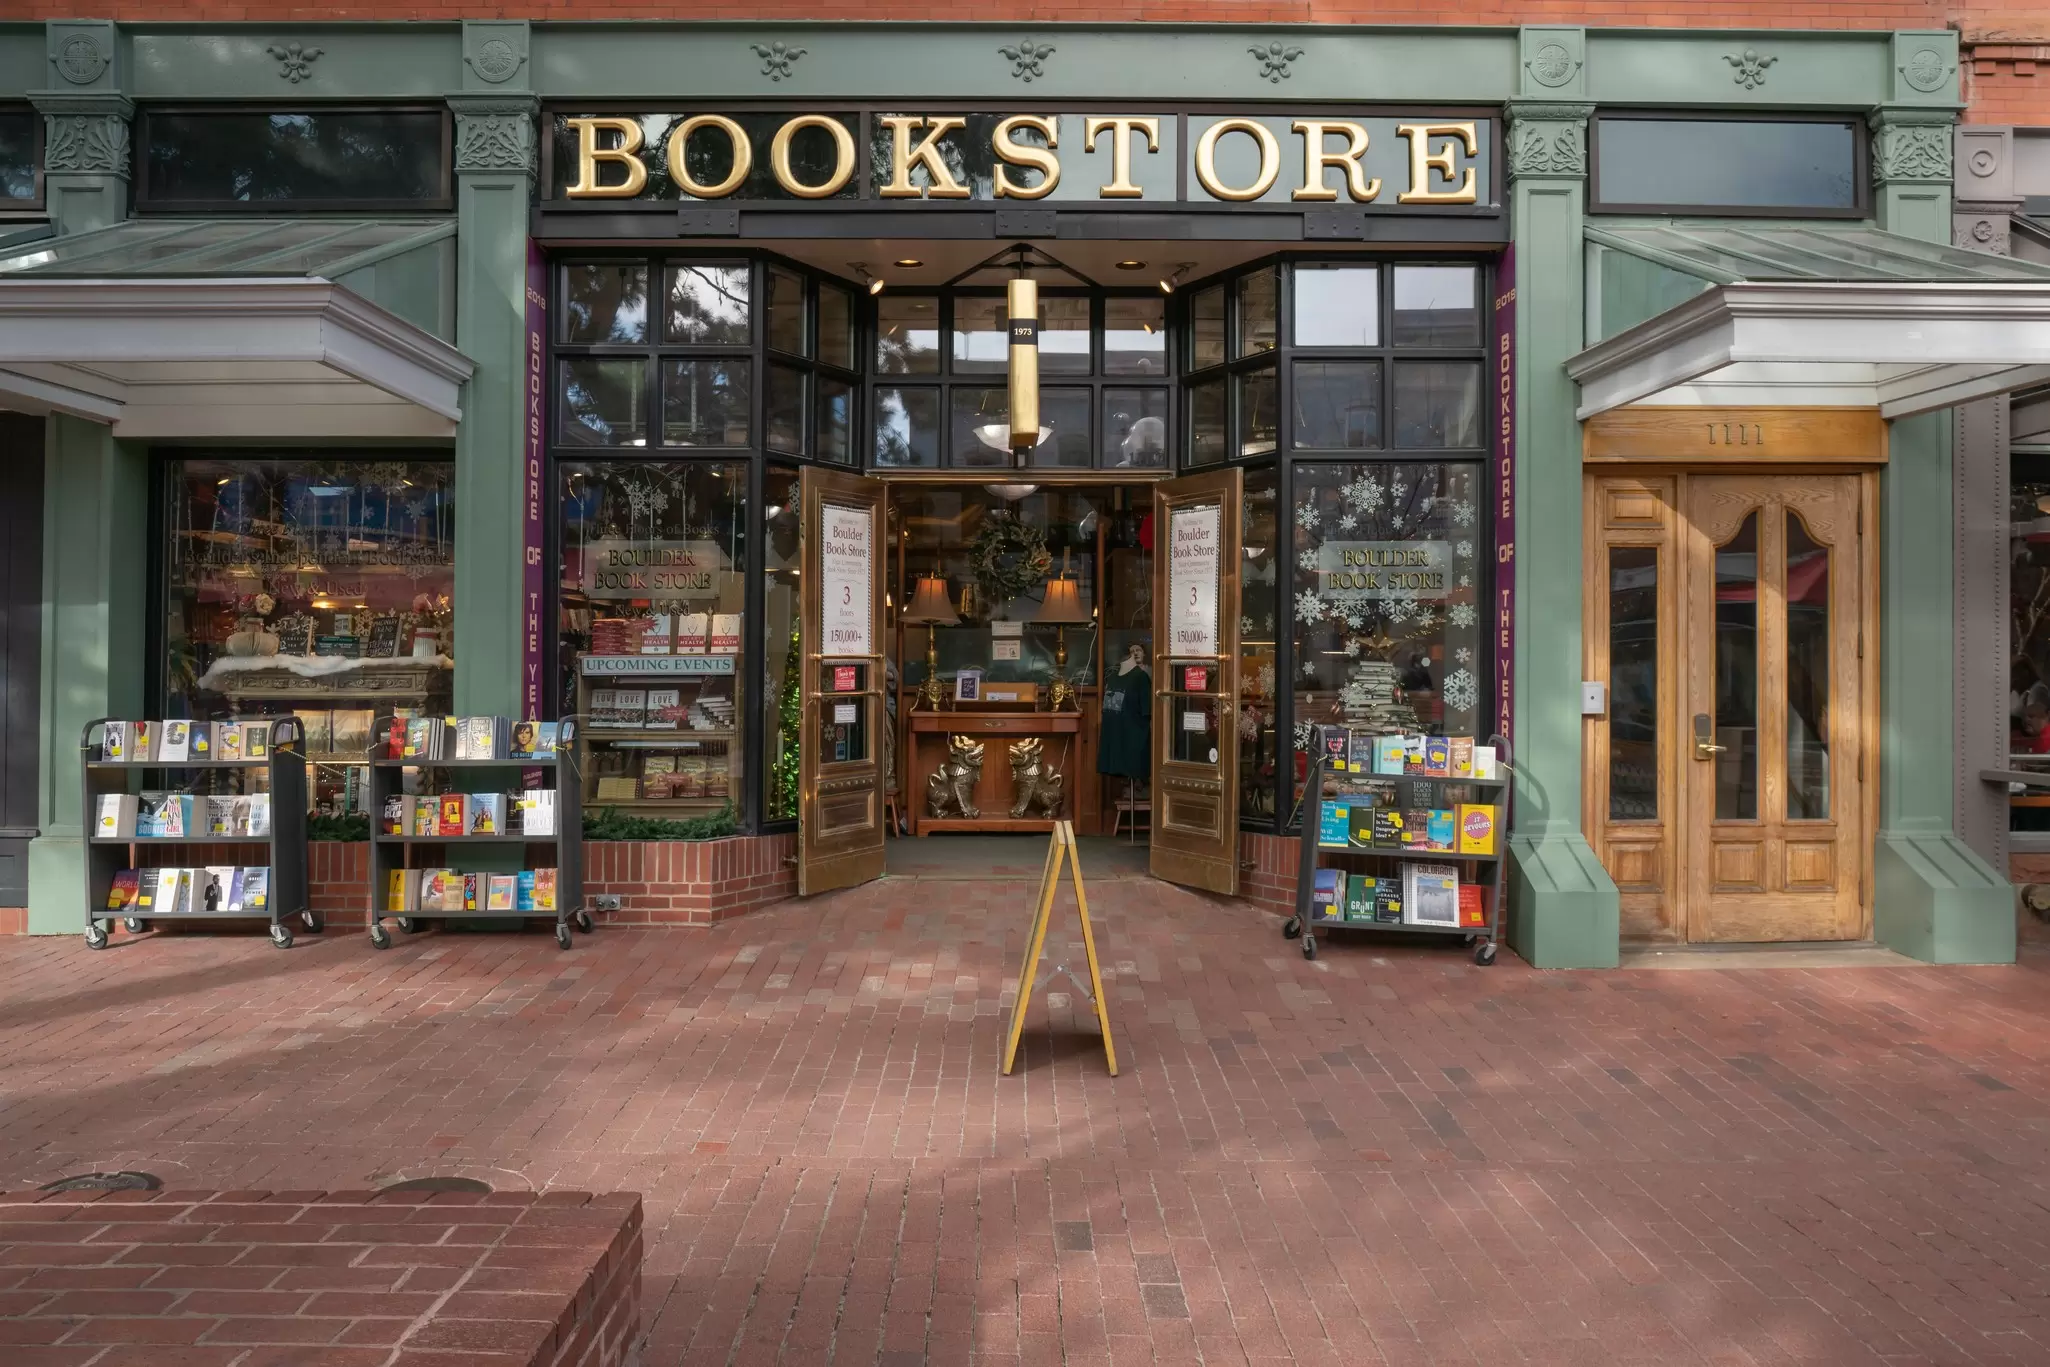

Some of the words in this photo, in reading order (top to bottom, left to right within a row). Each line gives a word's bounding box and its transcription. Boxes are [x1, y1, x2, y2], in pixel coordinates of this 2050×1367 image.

[565, 115, 1478, 204] BOOKSTORE
[527, 287, 546, 310] 2018
[1495, 288, 1516, 310] 2018
[1014, 327, 1033, 336] 1973
[530, 332, 540, 520] BOOKSTORE
[1501, 333, 1511, 518] BOOKSTORE
[1706, 424, 1764, 445] 1111
[833, 525, 864, 541] Boulder
[1178, 527, 1210, 542] Boulder
[527, 547, 541, 565] OF
[609, 550, 696, 567] BOULDER
[826, 542, 847, 556] Book
[848, 543, 867, 558] Store
[1173, 544, 1192, 558] Book
[1193, 544, 1215, 558] Store
[1343, 550, 1429, 567] BOULDER
[1499, 543, 1513, 563] OF
[307, 581, 320, 596] &
[325, 580, 363, 596] Used
[594, 573, 648, 590] BOOK
[654, 573, 711, 590] STORE
[1329, 573, 1381, 590] BOOK
[1388, 573, 1444, 590] STORE
[843, 586, 851, 605] 3
[1188, 586, 1197, 606] 3
[660, 604, 691, 617] Used
[1501, 590, 1509, 648] THE
[529, 593, 537, 652] THE
[831, 630, 862, 644] 150,000+
[1177, 630, 1208, 644] 150,000+
[586, 659, 669, 670] UPCOMING
[674, 658, 731, 670] EVENTS
[529, 664, 537, 722] YEA
[596, 695, 616, 703] LOVE
[620, 695, 640, 704] LOVE
[653, 695, 672, 704] LOVE
[1501, 660, 1509, 738] YEAR
[139, 825, 165, 834] SOONIS
[1417, 865, 1453, 875] COLORADO
[1351, 901, 1374, 913] GRUNT
